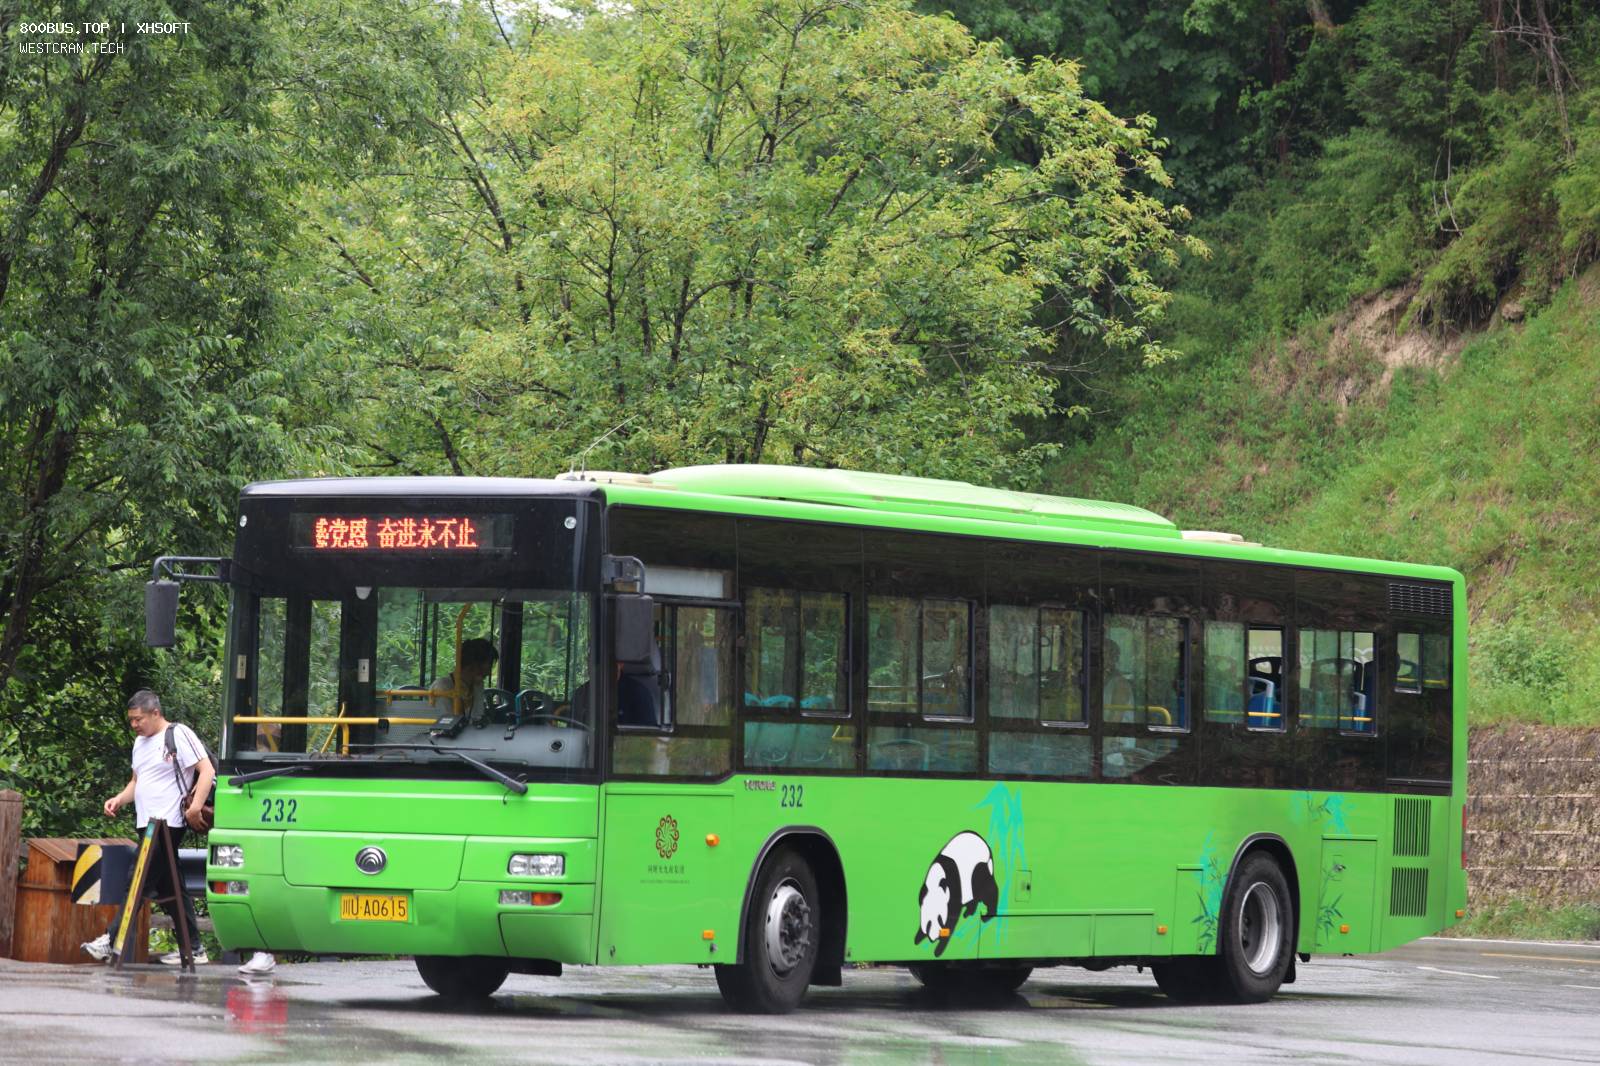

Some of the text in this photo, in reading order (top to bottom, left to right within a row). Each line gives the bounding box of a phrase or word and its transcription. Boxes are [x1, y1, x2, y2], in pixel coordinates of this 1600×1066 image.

[376, 517, 477, 549] 奋进永不止
[781, 784, 803, 808] 232
[261, 798, 297, 823] 232
